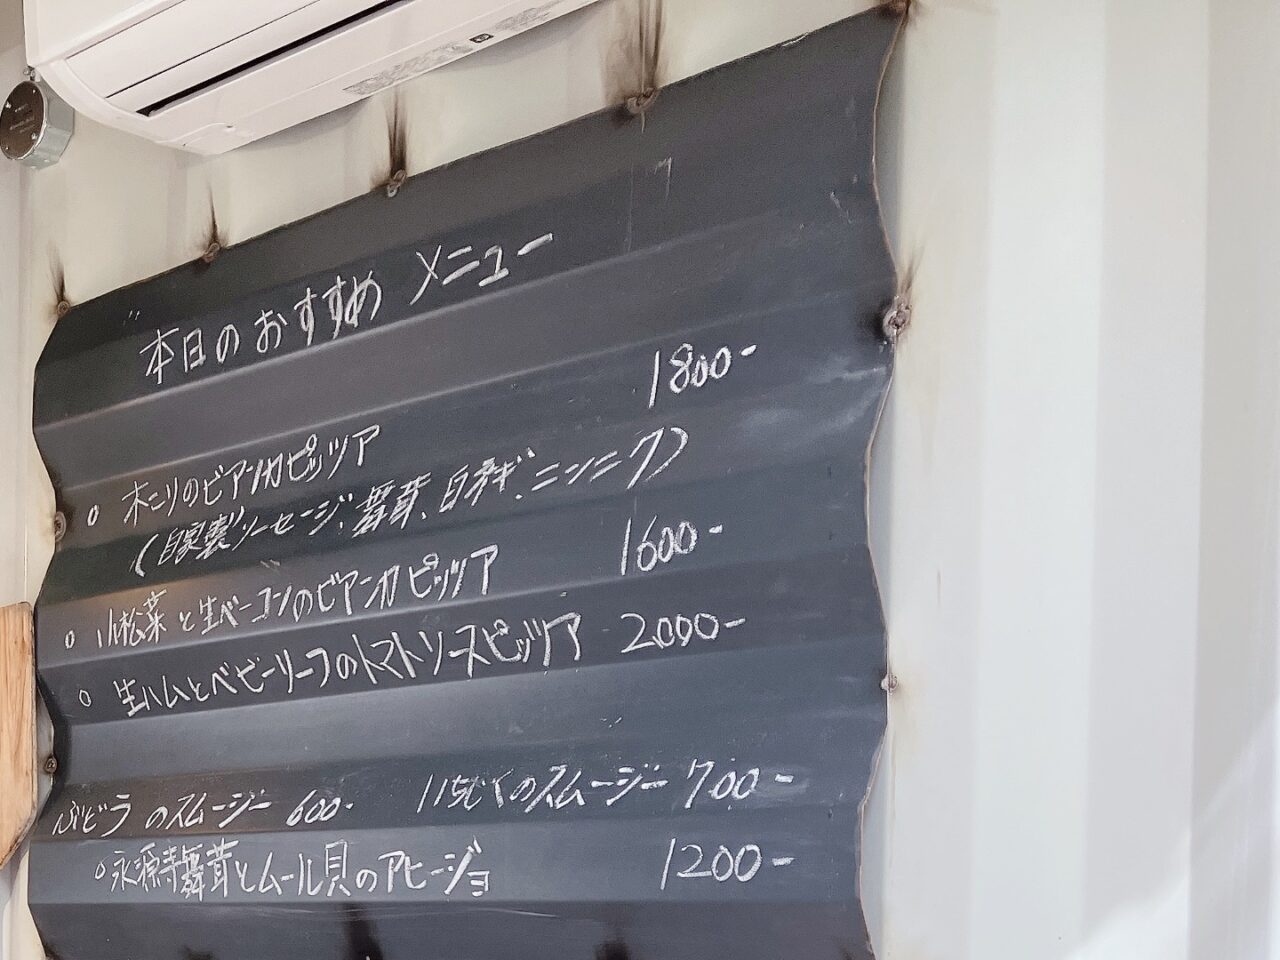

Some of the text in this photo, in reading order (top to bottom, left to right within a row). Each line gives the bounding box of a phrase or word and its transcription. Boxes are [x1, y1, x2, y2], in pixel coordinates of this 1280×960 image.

[139, 232, 554, 384] 本日のおすすめ メニュー
